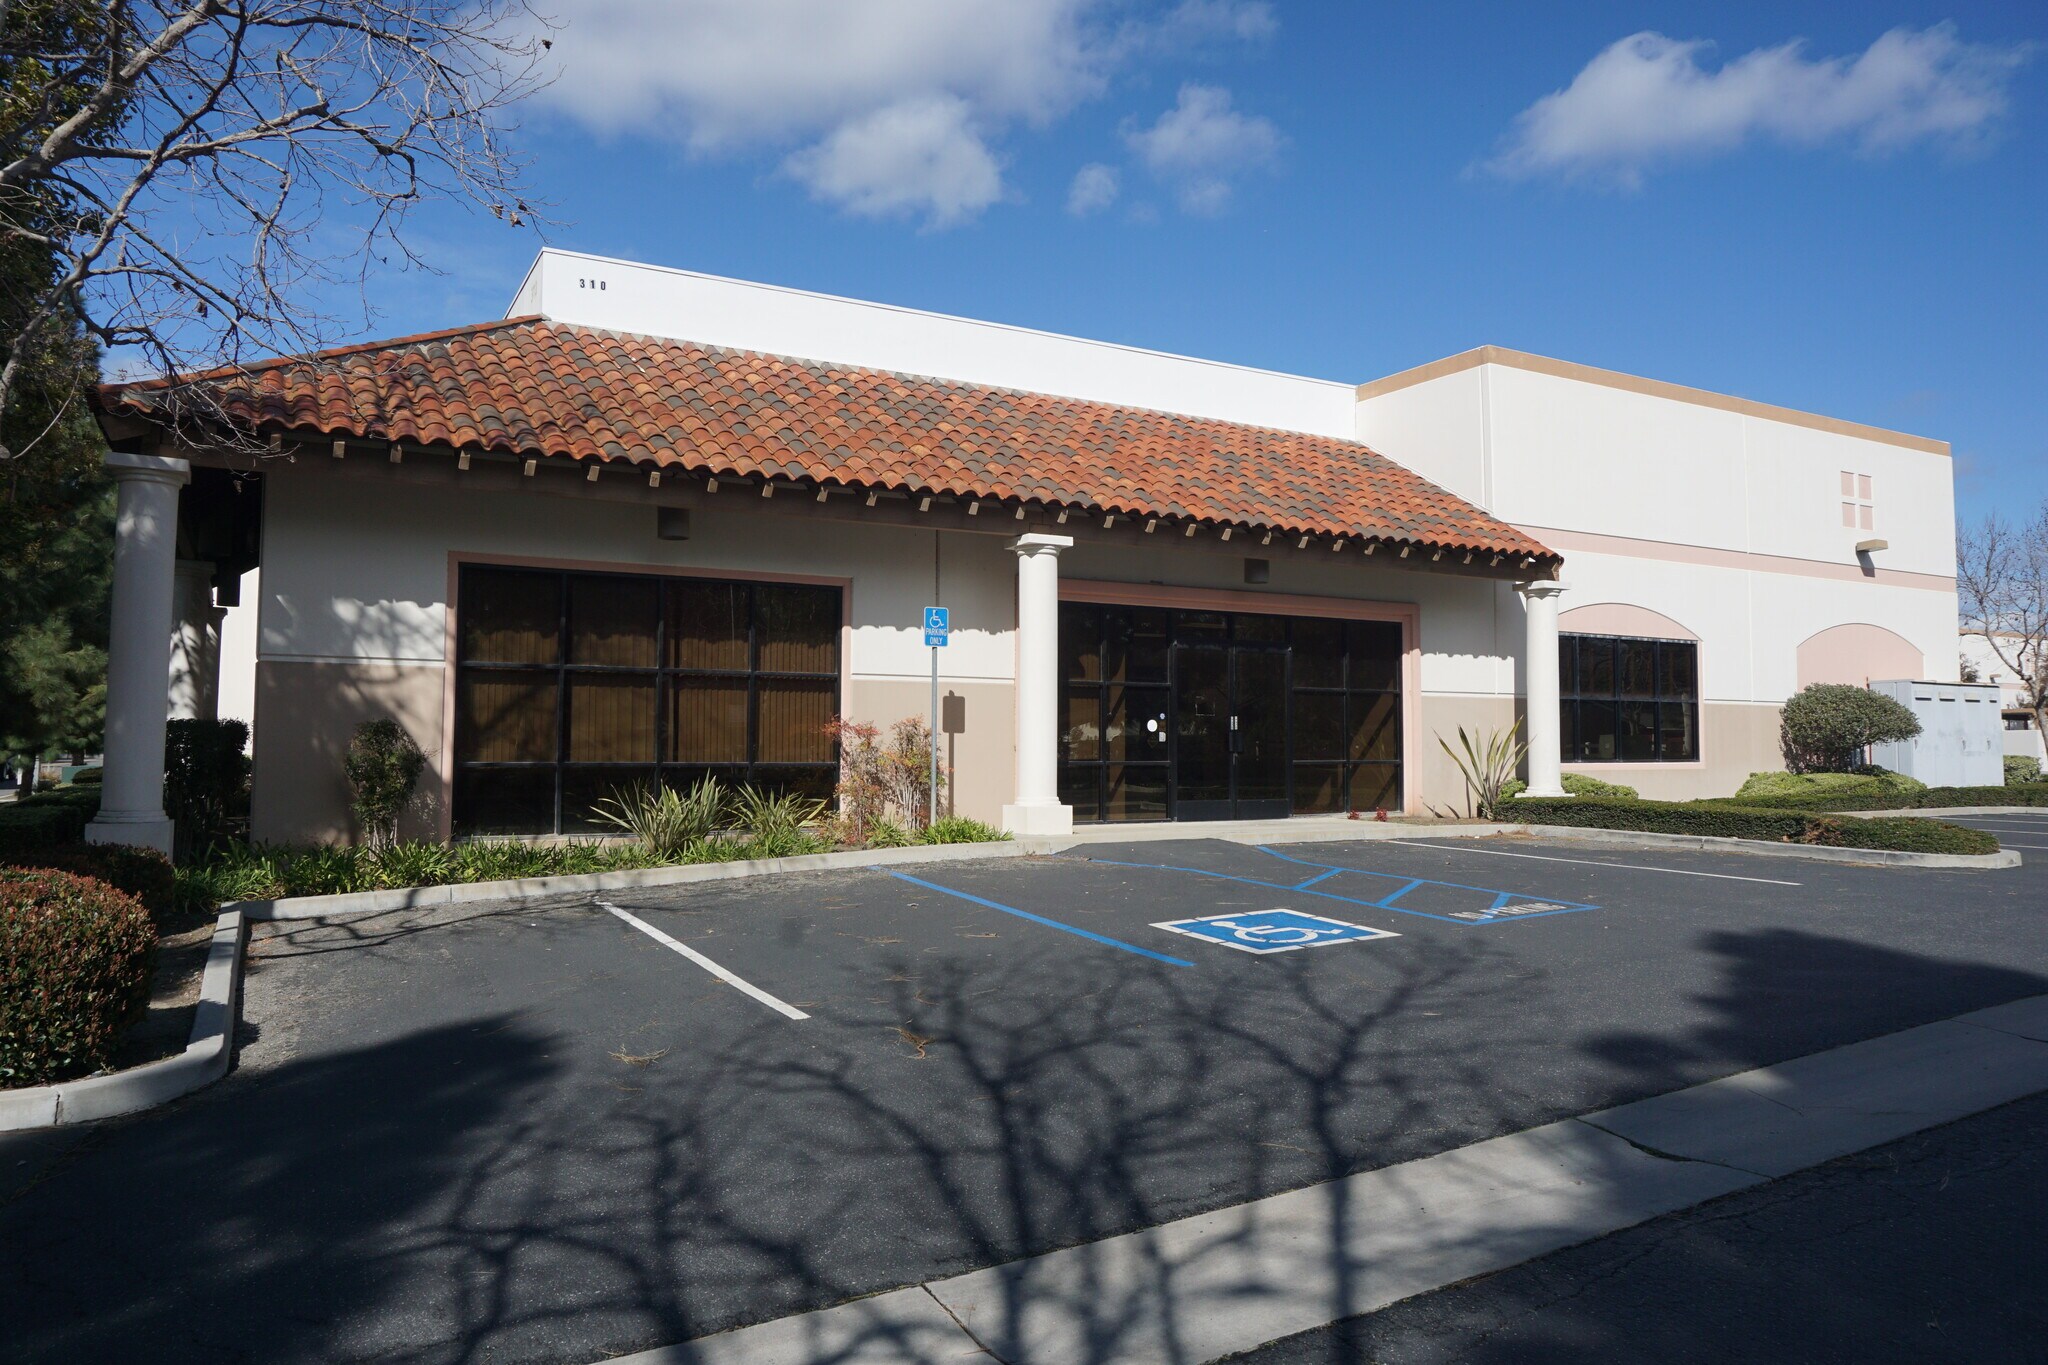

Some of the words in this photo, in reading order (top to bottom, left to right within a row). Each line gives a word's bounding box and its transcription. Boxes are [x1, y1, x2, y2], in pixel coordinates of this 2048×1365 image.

[579, 278, 606, 291] 310
[925, 628, 947, 636] PARKING
[929, 636, 943, 645] ONLY
